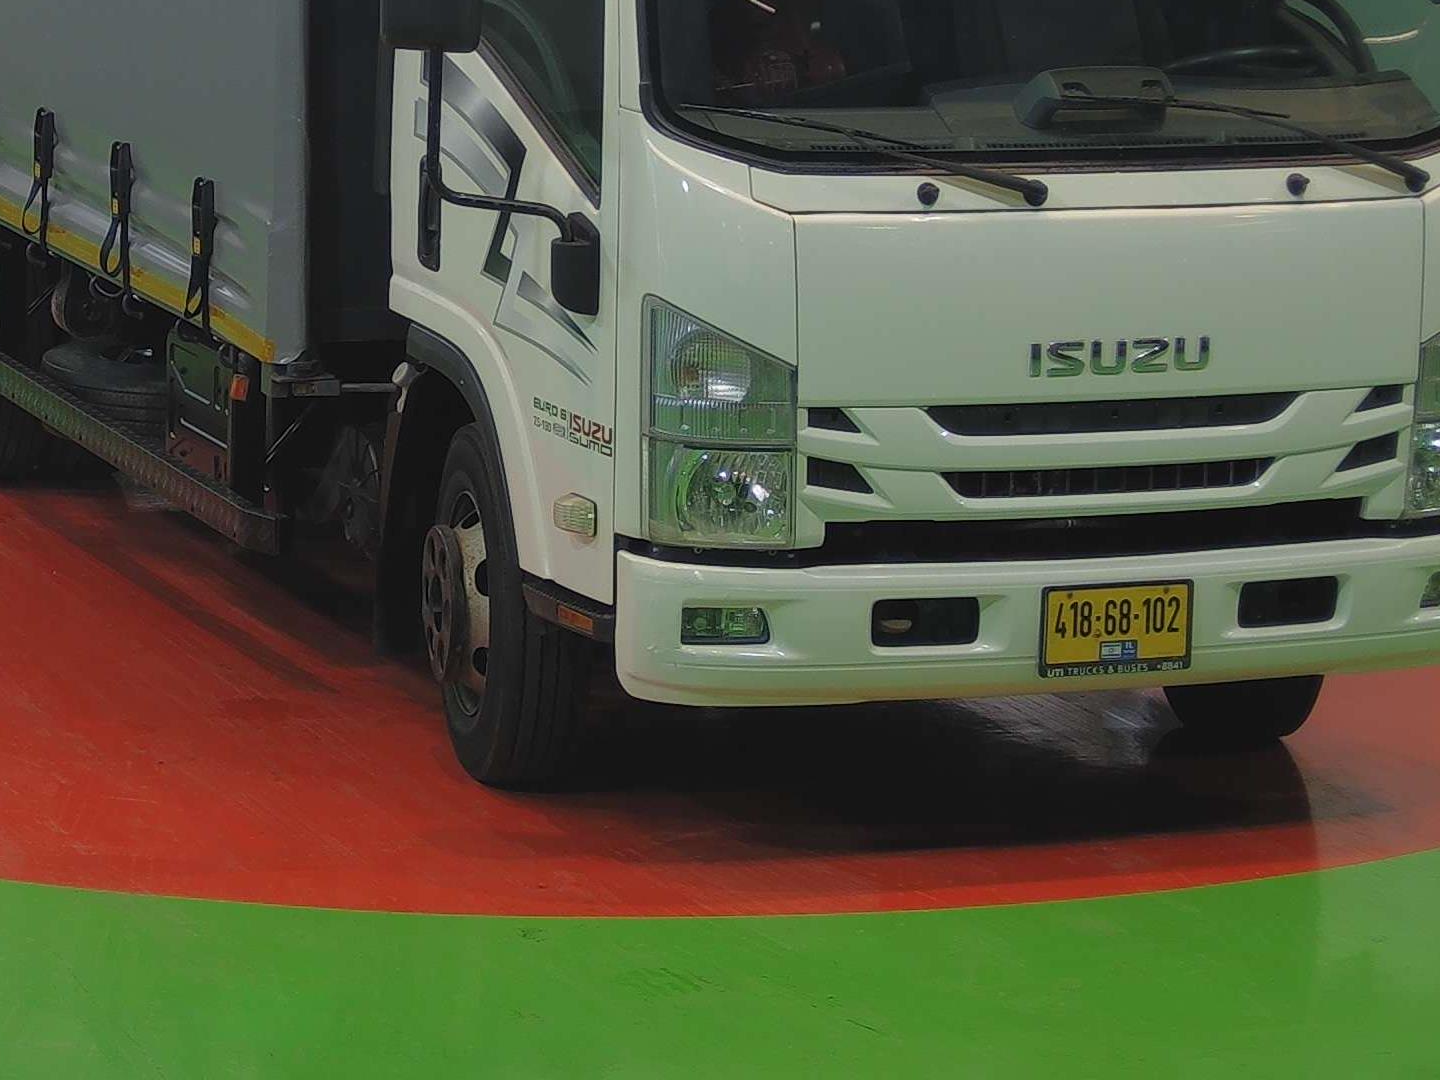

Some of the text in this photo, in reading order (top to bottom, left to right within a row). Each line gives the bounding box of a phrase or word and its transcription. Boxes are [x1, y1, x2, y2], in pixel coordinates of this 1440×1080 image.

[1029, 335, 1210, 377] ISUZU
[533, 396, 558, 418] EURO
[569, 412, 612, 445] ISUZU
[569, 431, 612, 458] SUMO
[1067, 664, 1104, 676] TRUCKS
[1118, 662, 1148, 673] BUSES
